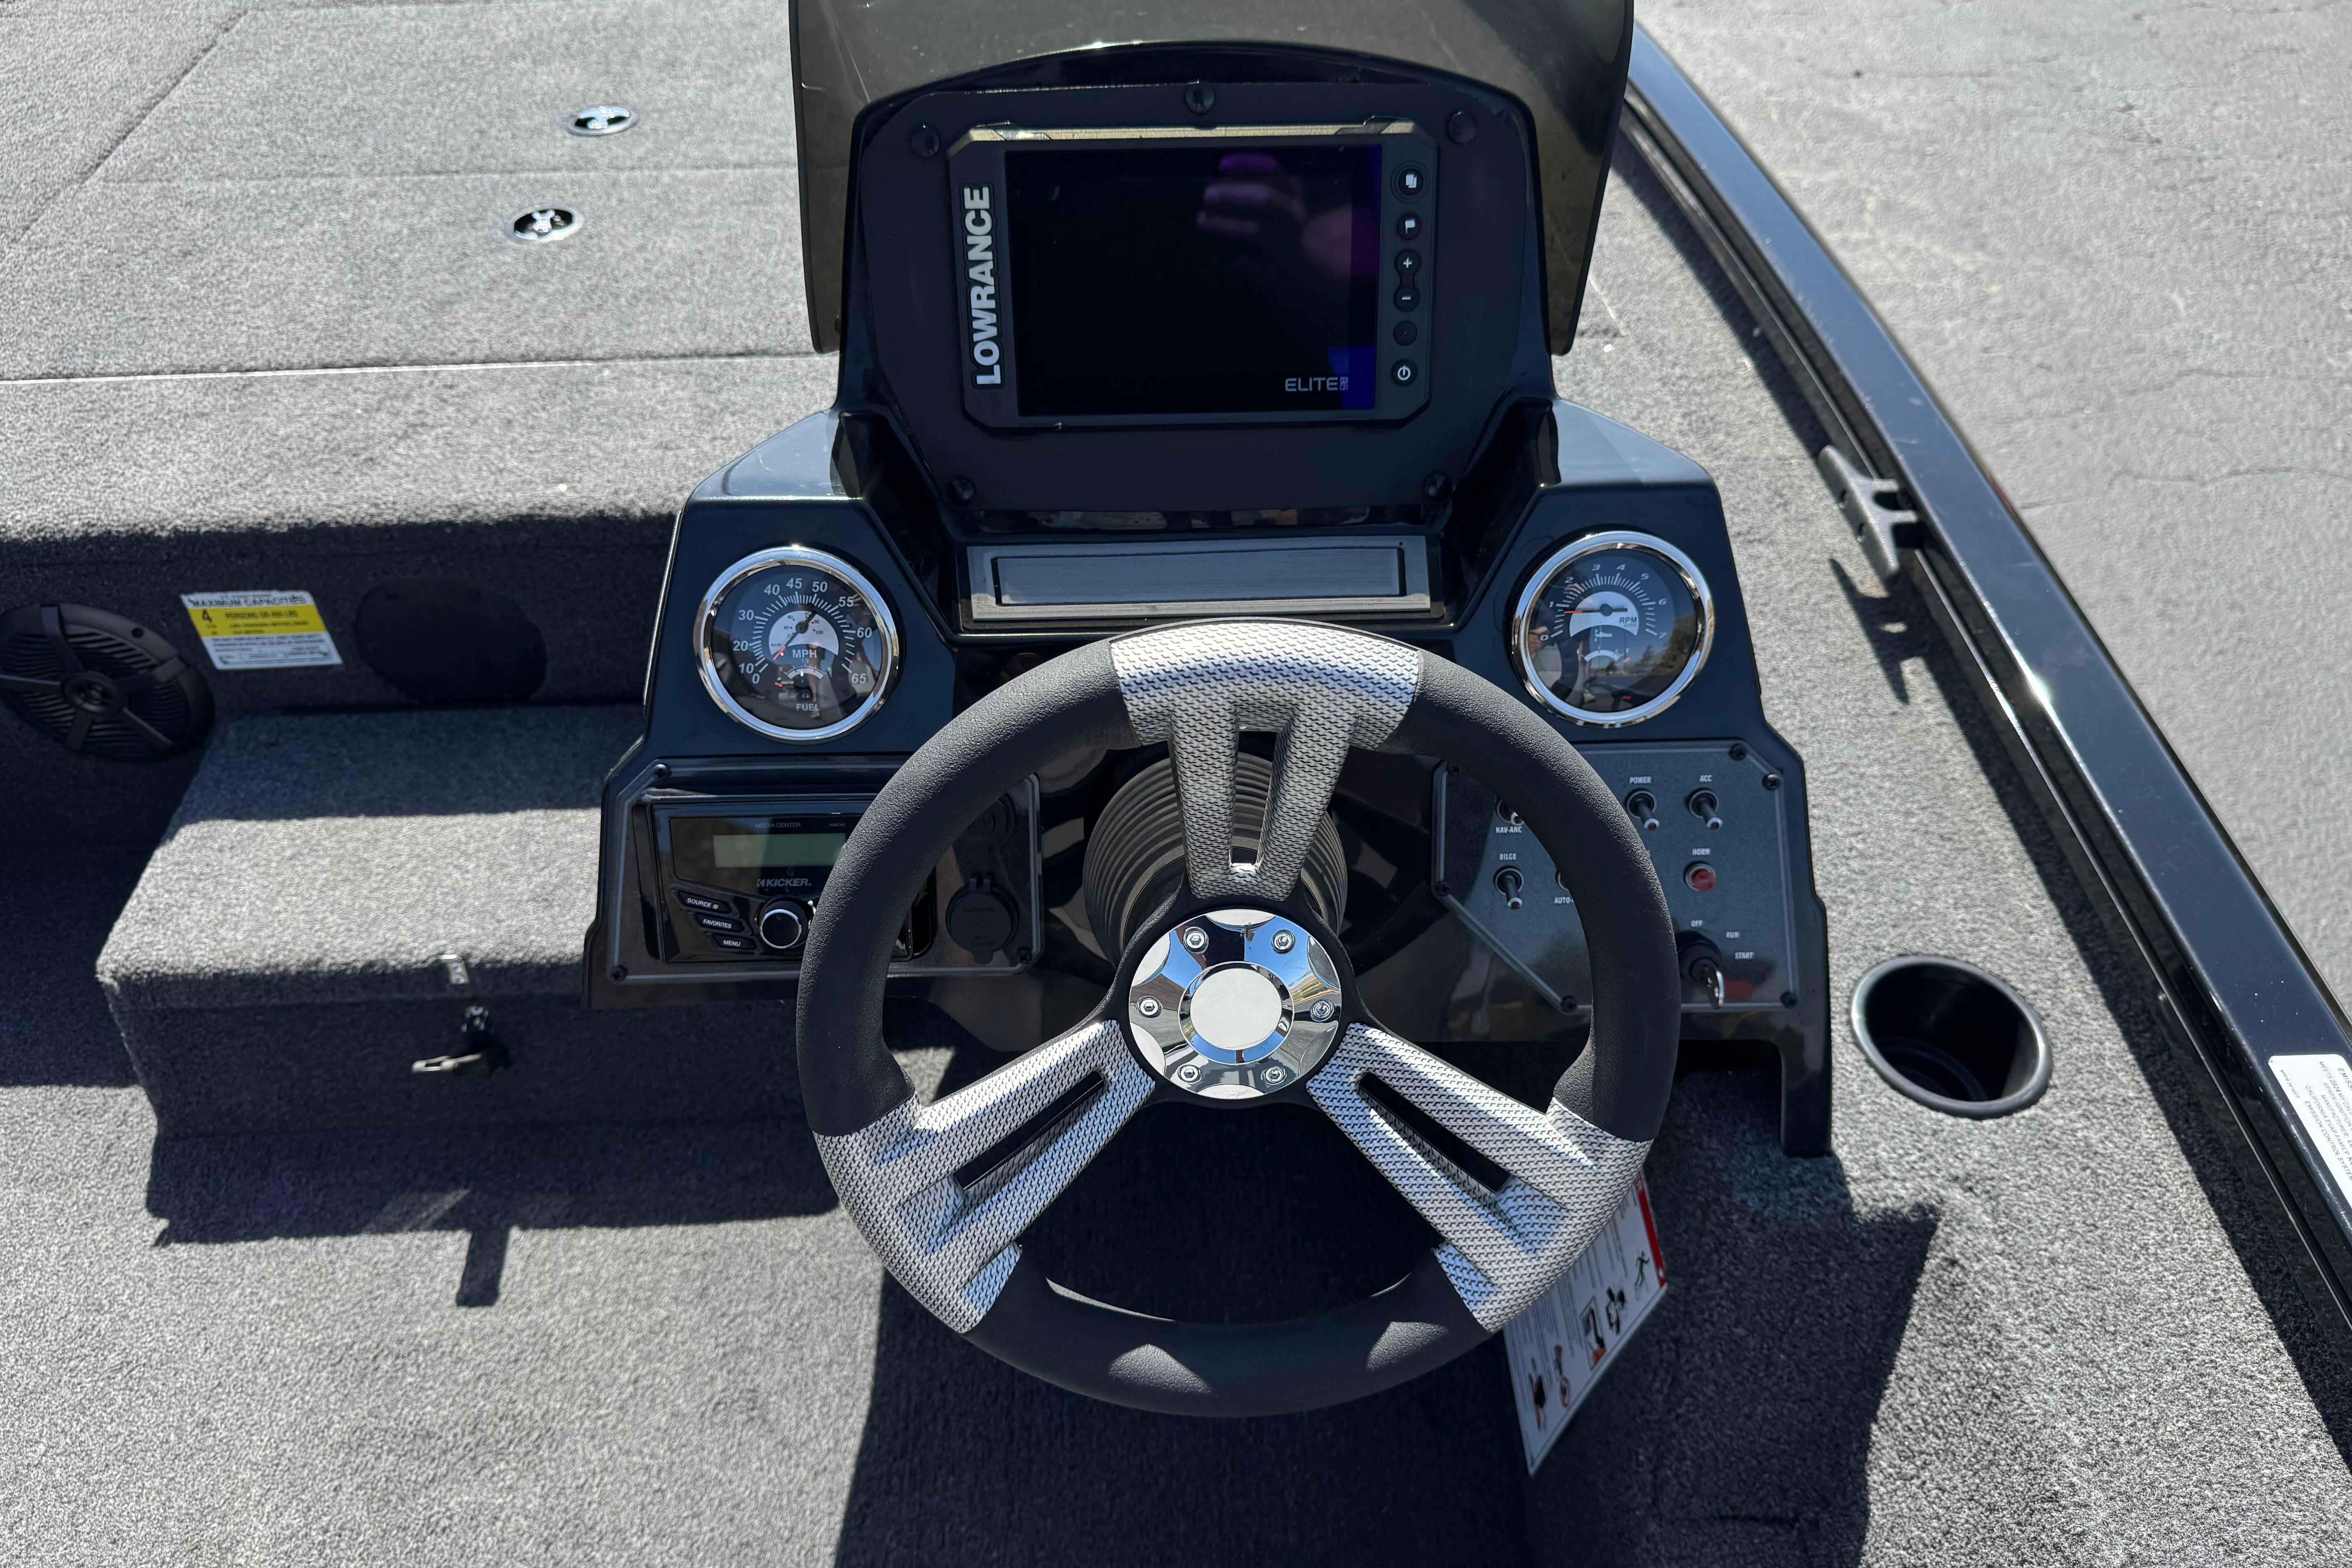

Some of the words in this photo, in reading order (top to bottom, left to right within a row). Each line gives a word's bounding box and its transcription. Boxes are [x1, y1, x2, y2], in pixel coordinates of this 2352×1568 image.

[964, 187, 1001, 385] LOWRANCE
[1285, 377, 1338, 392] ELITE
[786, 578, 802, 589] 45
[812, 581, 828, 593] 50
[764, 584, 780, 595] 40
[838, 596, 854, 607] 55
[202, 609, 212, 621] 4
[738, 609, 754, 621] 30
[856, 627, 872, 638] 60
[733, 640, 748, 651] 20
[792, 649, 817, 658] MPH
[739, 663, 754, 674] 10
[752, 673, 760, 684] 0
[852, 673, 867, 684] 65
[796, 703, 819, 712] FUEL
[687, 898, 712, 908] SOURCE
[703, 919, 732, 929] FAVORITES
[1734, 952, 1755, 960] START
[2319, 1062, 2333, 1079] MEETS
[2305, 1085, 2328, 1118] CALIFORNIA
[2325, 1119, 2337, 1134] EVAP
[2305, 1101, 2324, 1128] EMISSION
[2321, 1129, 2340, 1156] CONTROL
